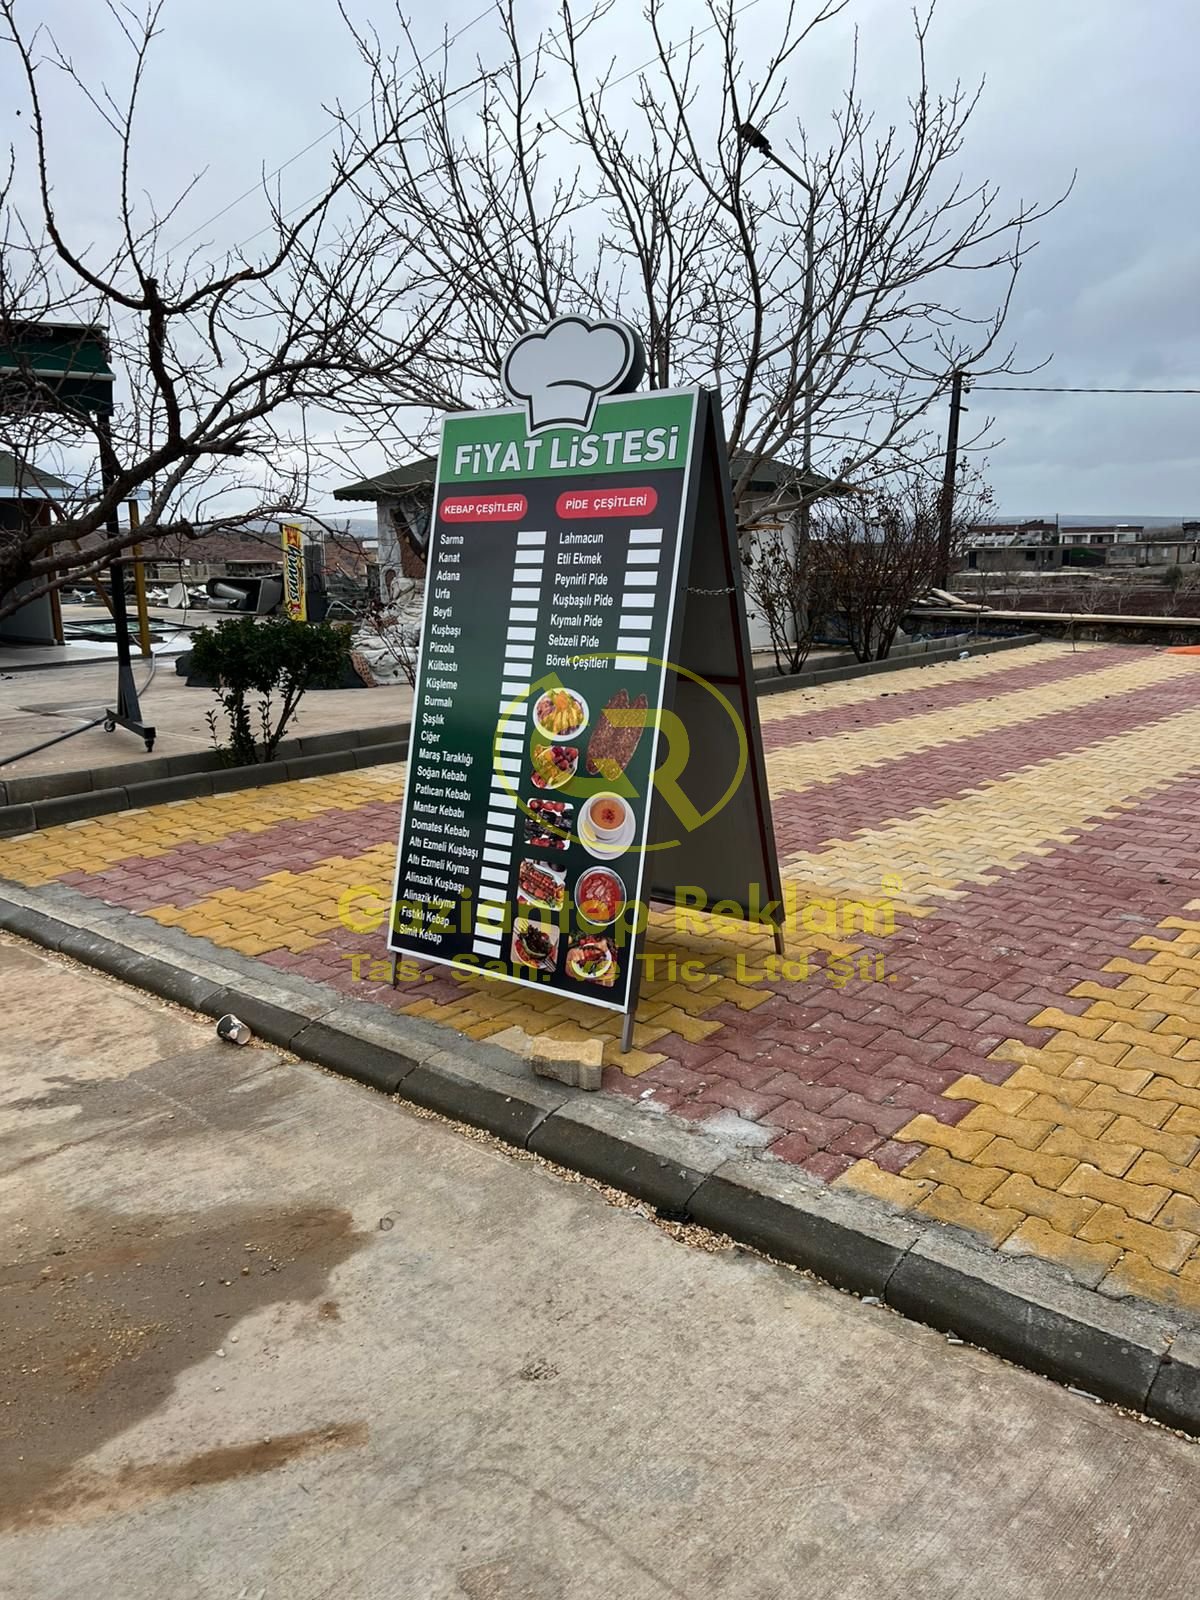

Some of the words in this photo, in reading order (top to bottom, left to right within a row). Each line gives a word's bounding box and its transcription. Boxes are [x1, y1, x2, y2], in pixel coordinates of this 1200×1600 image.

[444, 504, 474, 515] KEBAP
[476, 499, 523, 515] ÇEŞİTLERİ
[565, 498, 589, 510] PİDE
[593, 493, 648, 511] ÇEŞİTLERİ
[440, 534, 464, 545] Sarma
[559, 532, 604, 544] Lahmacun
[438, 552, 460, 563] Kanat
[557, 552, 572, 565] Etli
[573, 552, 602, 565] Ekmek
[436, 570, 460, 581] Adana
[555, 573, 587, 588] Peynirli
[588, 573, 608, 586] Pide
[435, 588, 451, 599] Urfa
[552, 593, 592, 609] Kuşbaşılı
[593, 594, 613, 606] Pide
[433, 606, 452, 620] Beyti
[550, 613, 582, 629] Kıymalı
[583, 614, 603, 627] Pide
[431, 624, 461, 638] Kuşbaşı
[548, 633, 579, 647] Sebzeli
[580, 635, 600, 647] Pide
[429, 642, 454, 654] Pirzola
[427, 659, 458, 672] Külbastı
[546, 654, 571, 667] Börek
[573, 655, 608, 671] Çeşitleri
[426, 677, 458, 691] Küşleme
[424, 695, 453, 708] Burmalı
[422, 713, 445, 726] Şaşlık
[420, 731, 440, 744] Ciğer
[419, 748, 440, 763] Maraş
[442, 751, 473, 766] Taraklığı
[417, 765, 440, 780] Soğan
[441, 768, 467, 782] Kebabı
[415, 783, 444, 798] Patlıcan
[445, 787, 471, 801] Kebabı
[413, 800, 438, 814] Mantar
[439, 804, 465, 818] Kebabı
[411, 818, 442, 833] Domates
[443, 822, 470, 838] Kebabı
[422, 838, 447, 852] Ezmeli
[448, 845, 479, 860] Kuşbaşı
[421, 856, 446, 870] Ezmeli
[446, 861, 470, 875] Kıyma
[405, 871, 433, 886] Alinazik
[434, 876, 465, 894] Kuşbaşı
[403, 888, 431, 904] Alinazik
[426, 911, 450, 927] Kebap
[400, 923, 418, 937] Simit
[419, 927, 442, 944] Kebap
